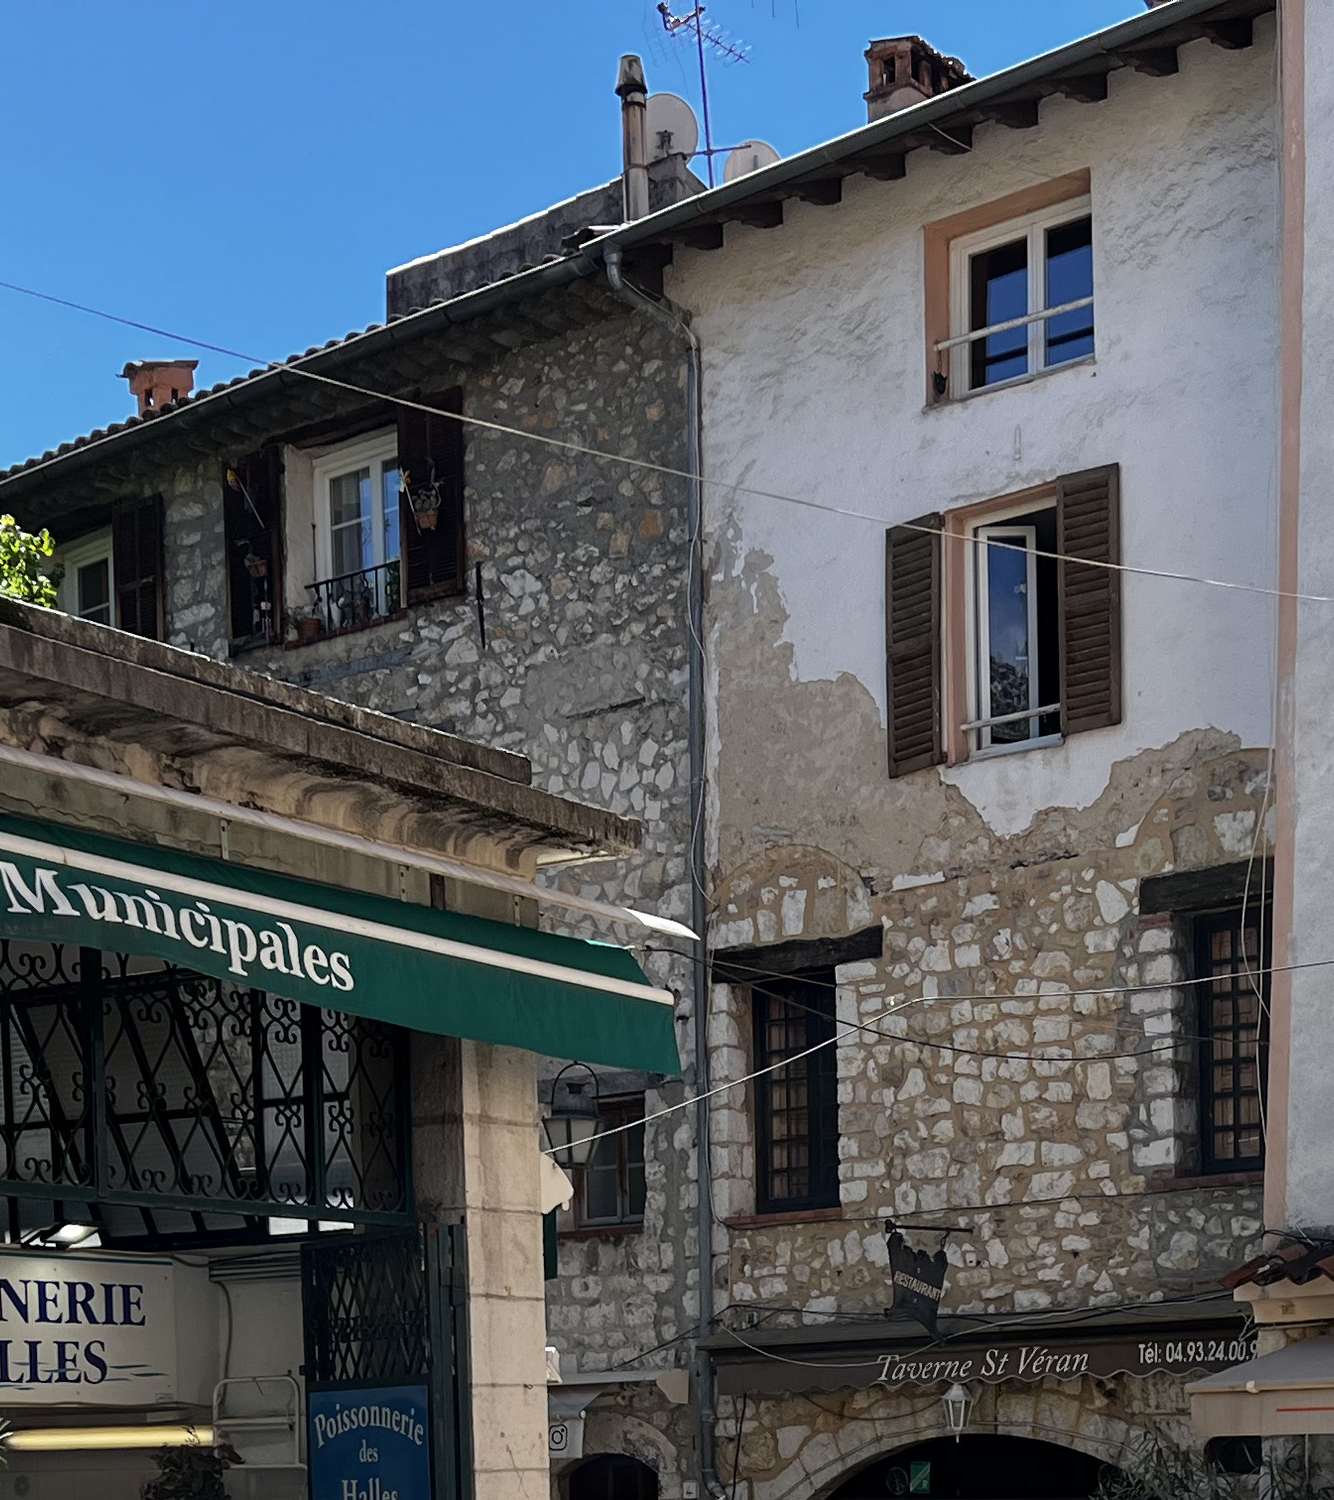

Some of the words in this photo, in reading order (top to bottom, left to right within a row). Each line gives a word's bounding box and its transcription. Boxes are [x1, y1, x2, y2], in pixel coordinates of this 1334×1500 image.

[894, 1271, 942, 1301] RESTAURANT
[877, 1353, 971, 1382] Taverne
[980, 1347, 1009, 1377] St
[1017, 1346, 1090, 1375] Véran
[1138, 1341, 1162, 1364] Tél:
[314, 1403, 424, 1448] Poissonnerie
[359, 1438, 379, 1463] des
